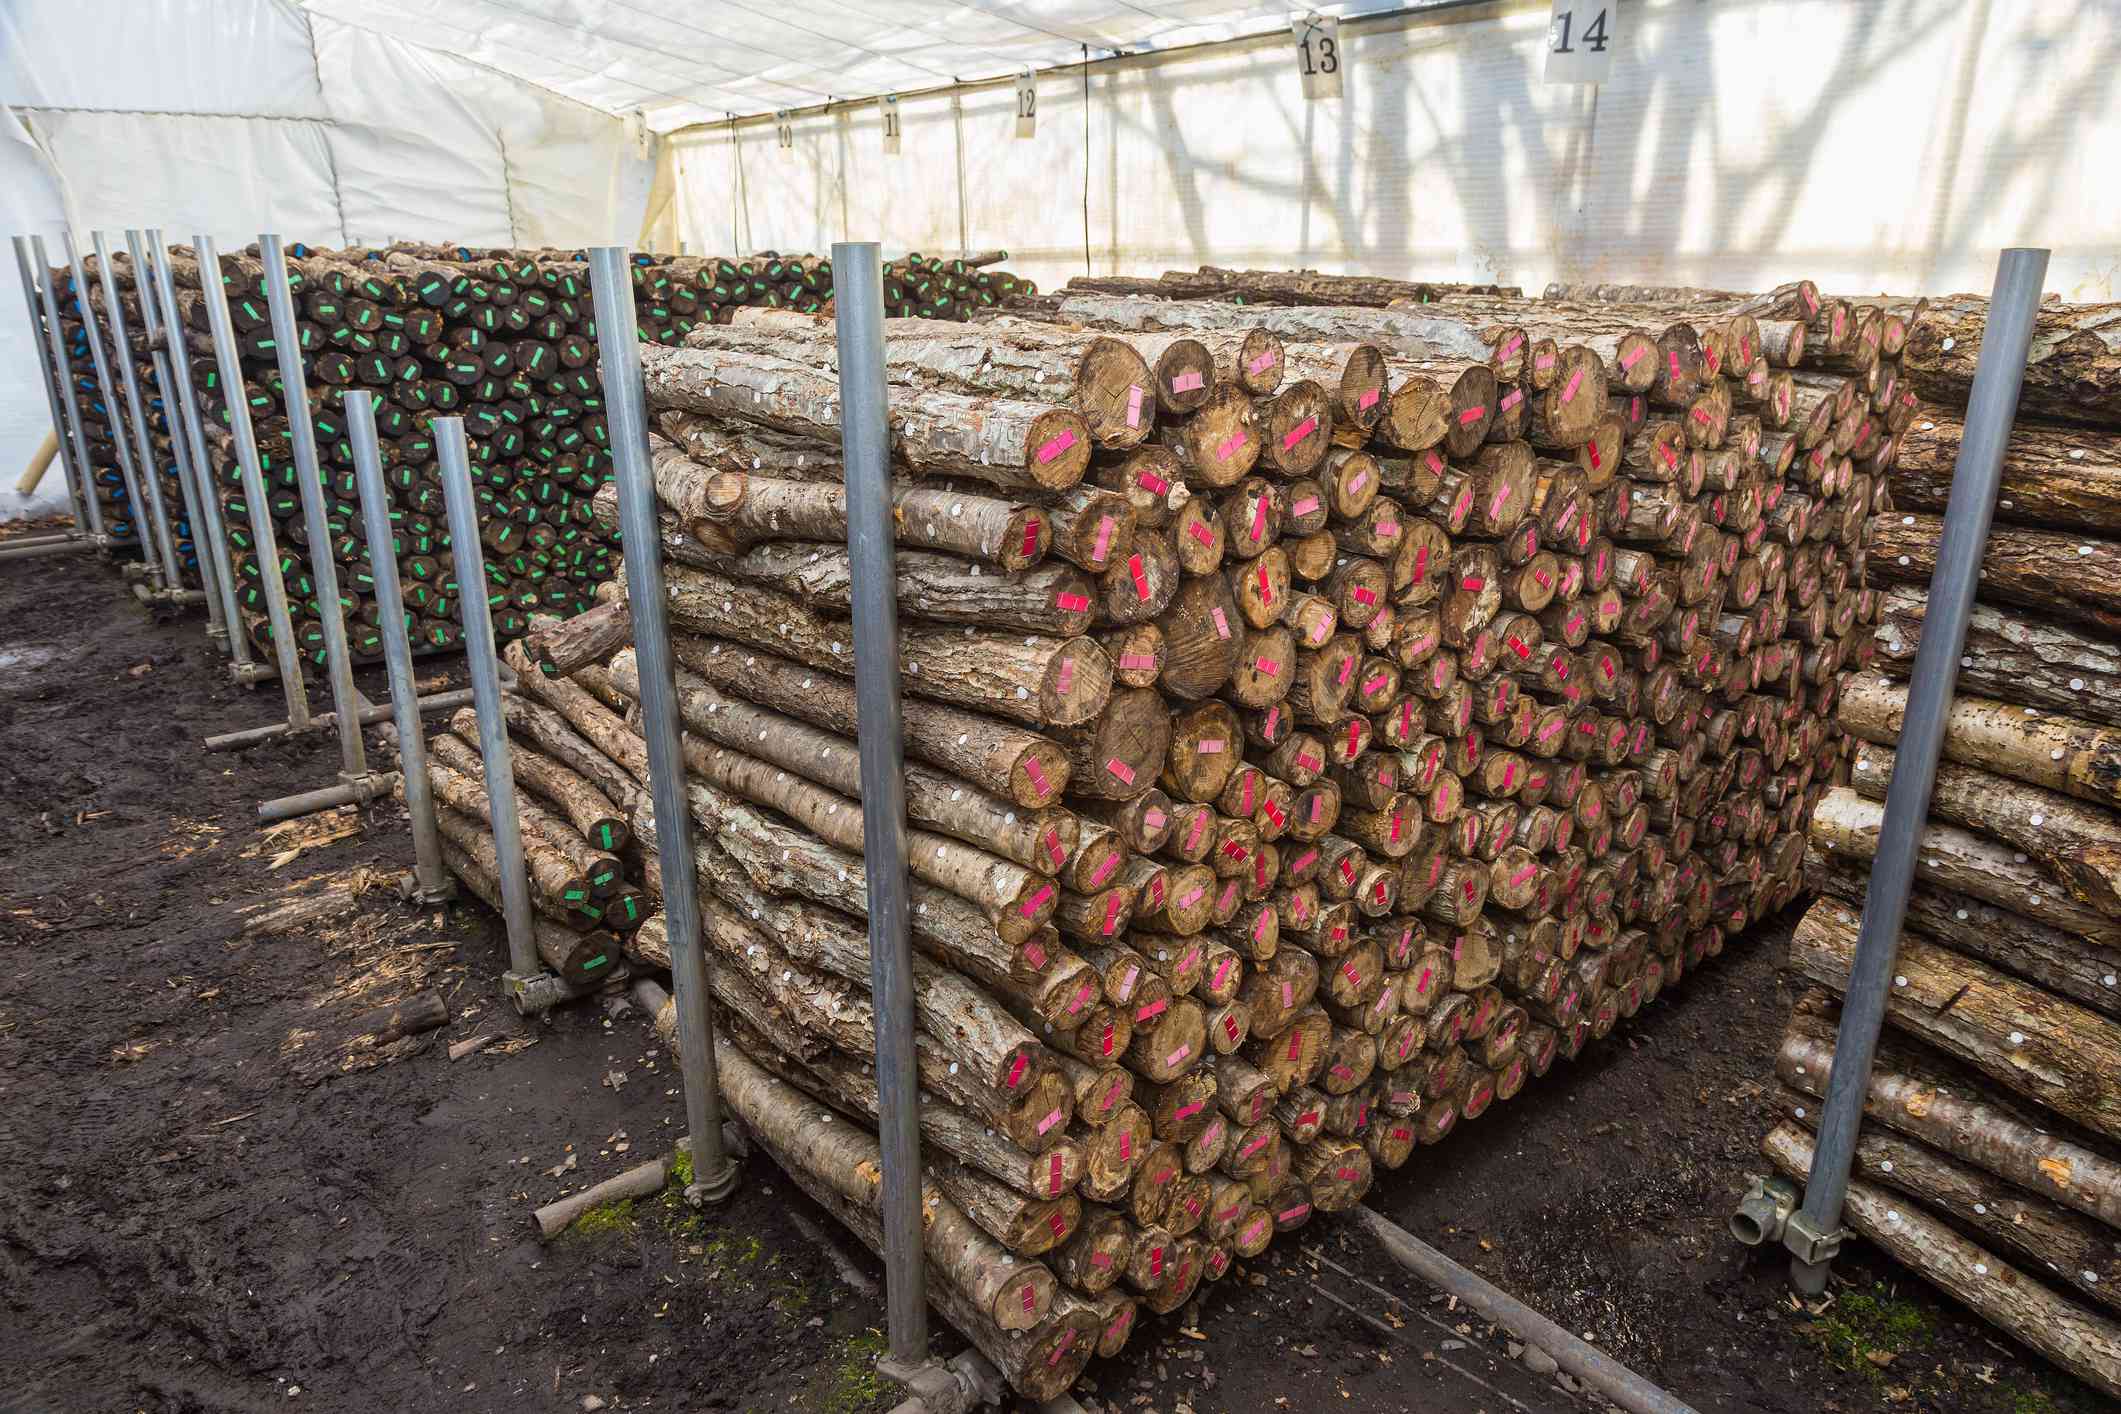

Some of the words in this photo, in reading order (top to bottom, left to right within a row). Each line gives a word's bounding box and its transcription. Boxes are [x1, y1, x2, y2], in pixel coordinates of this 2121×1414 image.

[1553, 8, 1609, 54] 14
[1300, 38, 1338, 75] 13
[1018, 88, 1036, 118] 12
[778, 125, 793, 148] 10
[885, 112, 900, 137] 11
